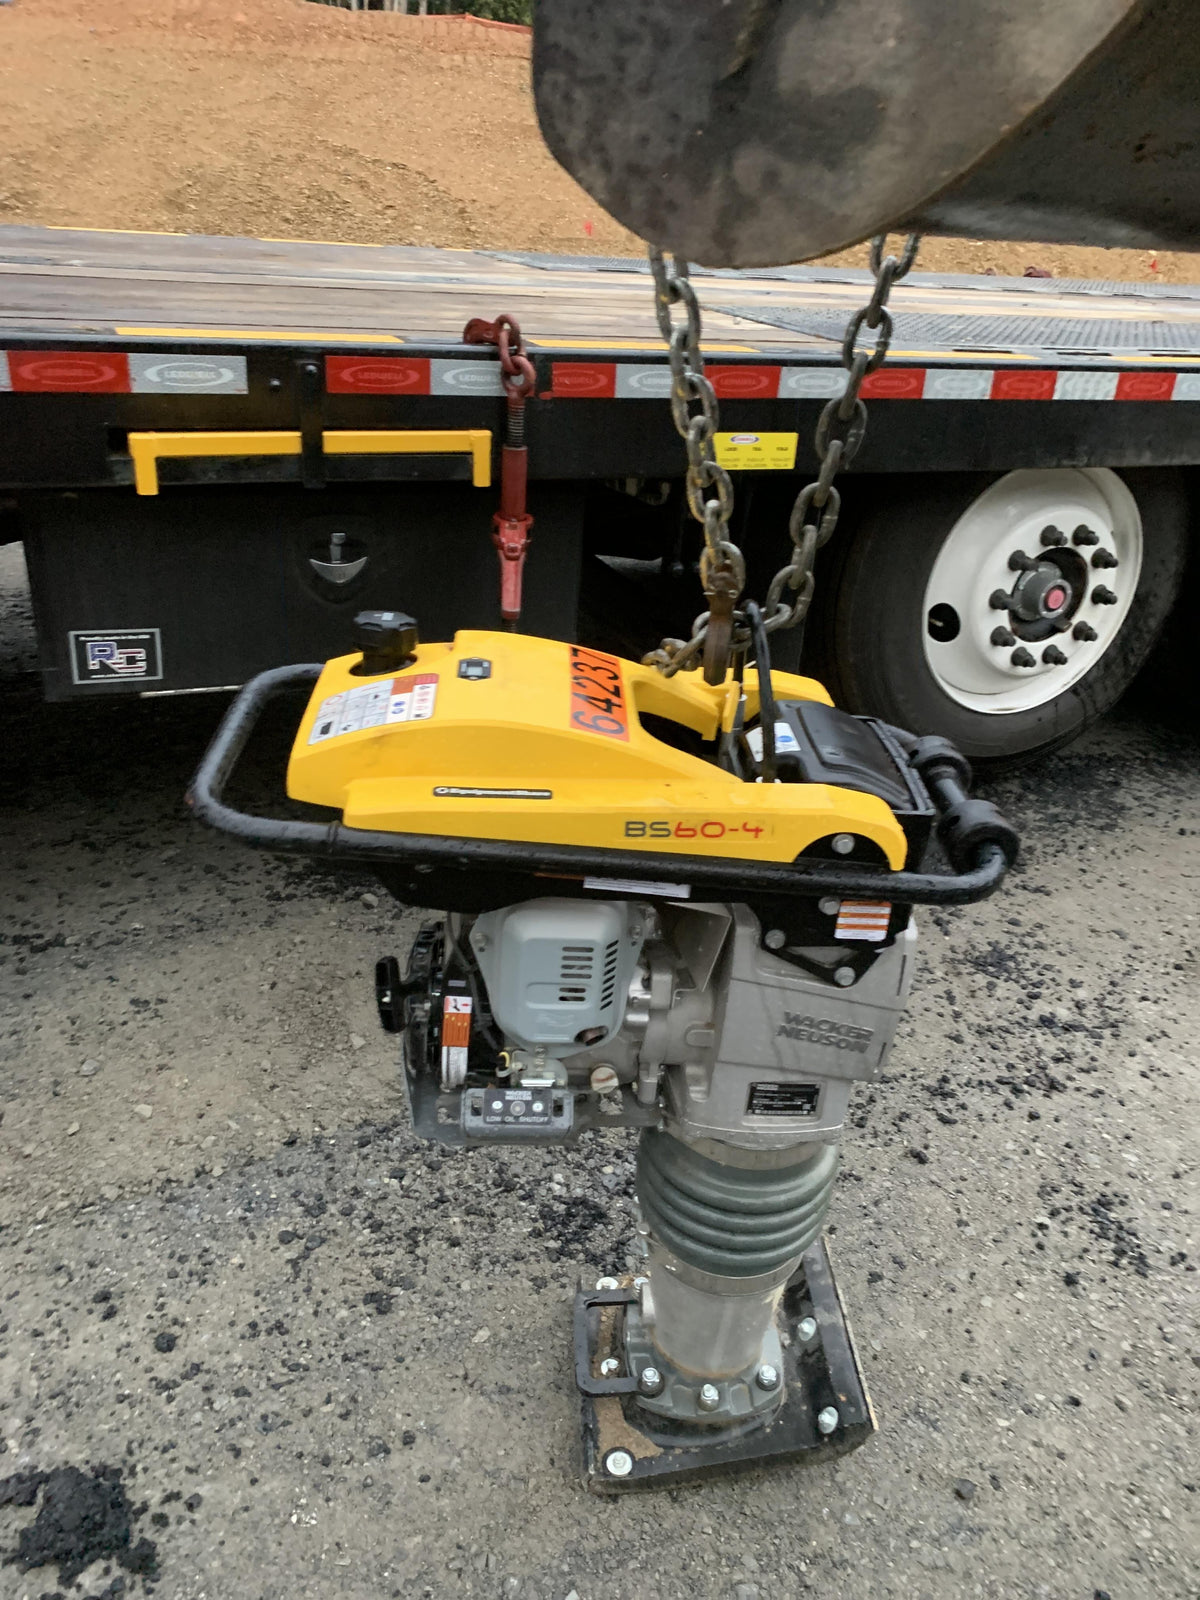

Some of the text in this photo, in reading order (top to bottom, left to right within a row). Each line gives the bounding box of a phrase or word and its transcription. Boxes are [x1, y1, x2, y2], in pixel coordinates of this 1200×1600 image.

[572, 647, 625, 735] 64237
[625, 821, 764, 839] BS60-4
[776, 1023, 870, 1054] NEUSON
[783, 1009, 874, 1042] WACKER
